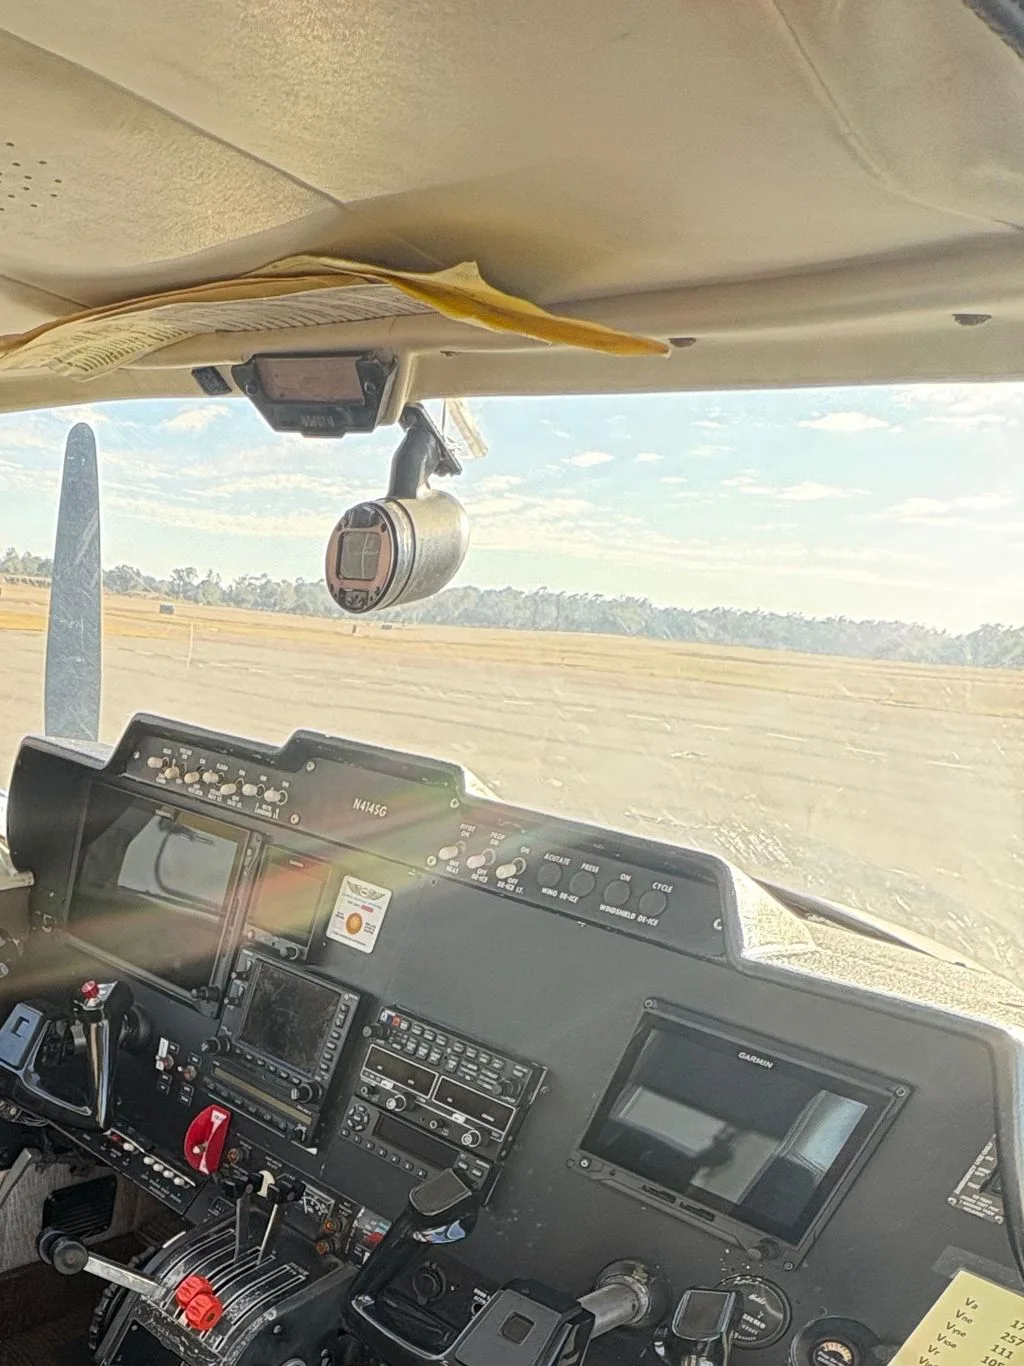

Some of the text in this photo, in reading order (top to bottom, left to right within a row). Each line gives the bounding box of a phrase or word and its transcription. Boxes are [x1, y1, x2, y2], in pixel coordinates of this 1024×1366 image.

[352, 797, 388, 817] N414SG
[460, 830, 471, 838] ON
[520, 846, 531, 855] ON
[543, 853, 571, 866] ACUTATE
[581, 862, 600, 874] PRESS
[507, 877, 519, 885] OFF
[619, 873, 632, 882] ON
[497, 881, 515, 891] DE-ICE
[652, 882, 673, 894] CYCLE
[541, 887, 579, 903] WING DE-ICE
[599, 904, 659, 927] WINDSHIELD DE-ICE
[738, 1051, 774, 1069] GARMIN
[965, 1297, 978, 1310] Va
[955, 1309, 1024, 1347] Vne 257
[936, 1333, 957, 1349] Vxse
[946, 1321, 1014, 1360] Vyse 111
[927, 1344, 941, 1356] Vr
